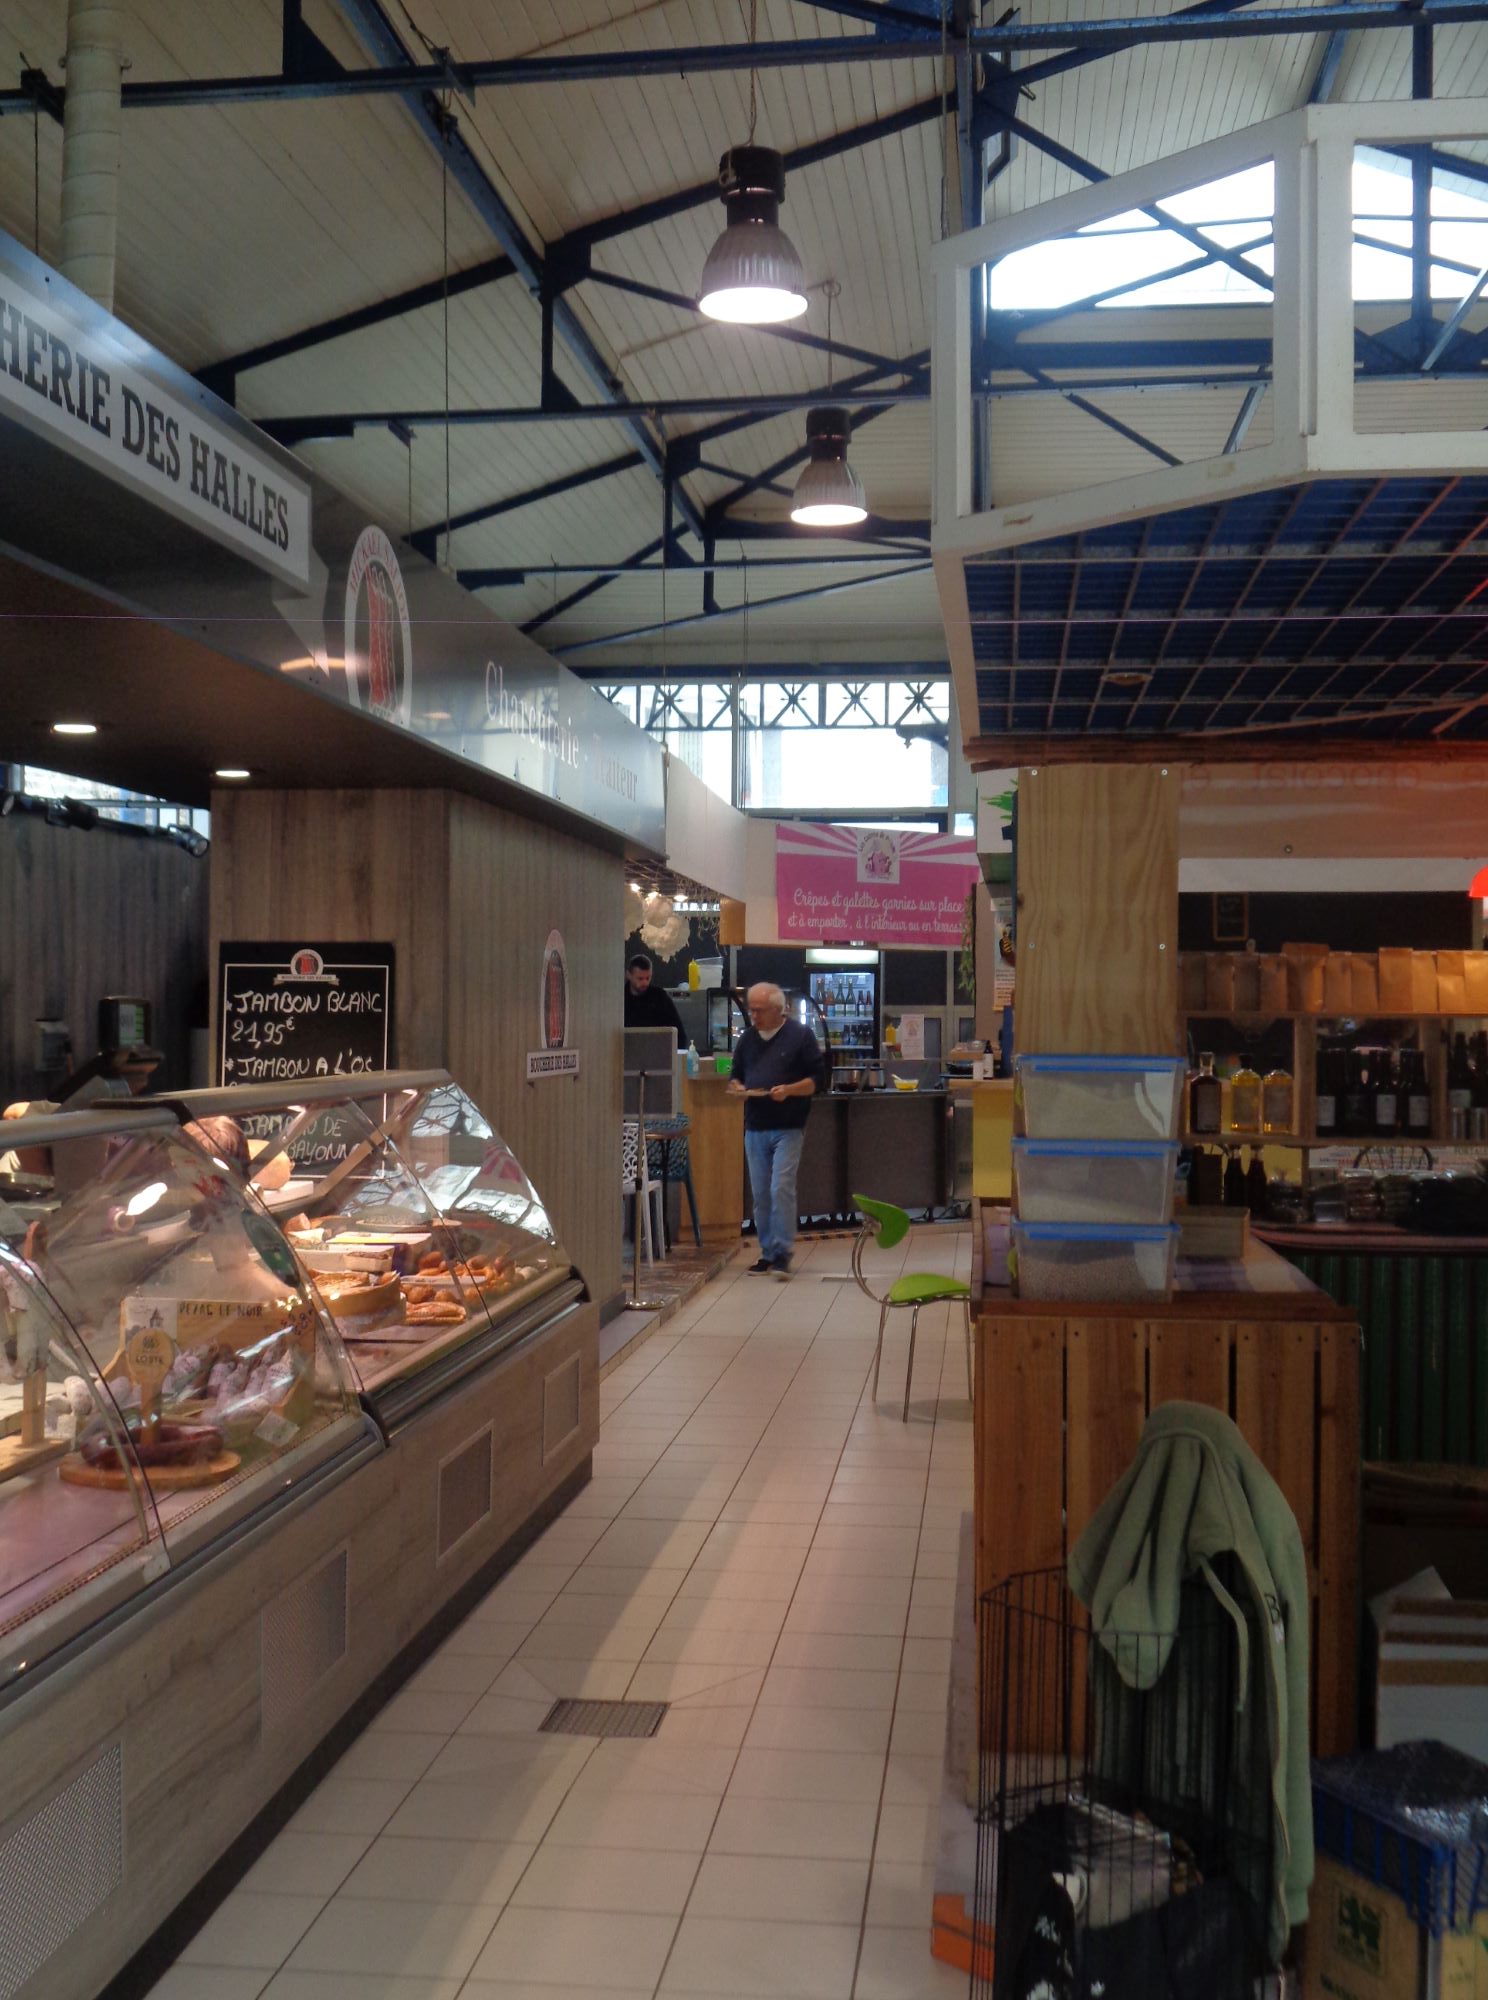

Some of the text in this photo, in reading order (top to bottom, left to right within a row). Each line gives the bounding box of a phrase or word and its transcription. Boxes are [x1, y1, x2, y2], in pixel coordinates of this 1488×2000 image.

[121, 384, 181, 483] DES
[190, 432, 289, 552] HALLES
[485, 660, 639, 802] Charcuterie Traiteur
[794, 888, 964, 918] Crêpes et galettes garnies sur place
[788, 911, 798, 928] et
[798, 914, 804, 928] à
[856, 916, 862, 929] à
[908, 922, 920, 932] ou
[921, 921, 932, 932] en
[234, 990, 383, 1014] JAMBON BLANC
[237, 1056, 310, 1079] JAMBON
[315, 1056, 328, 1076] A
[323, 1115, 348, 1137] DE
